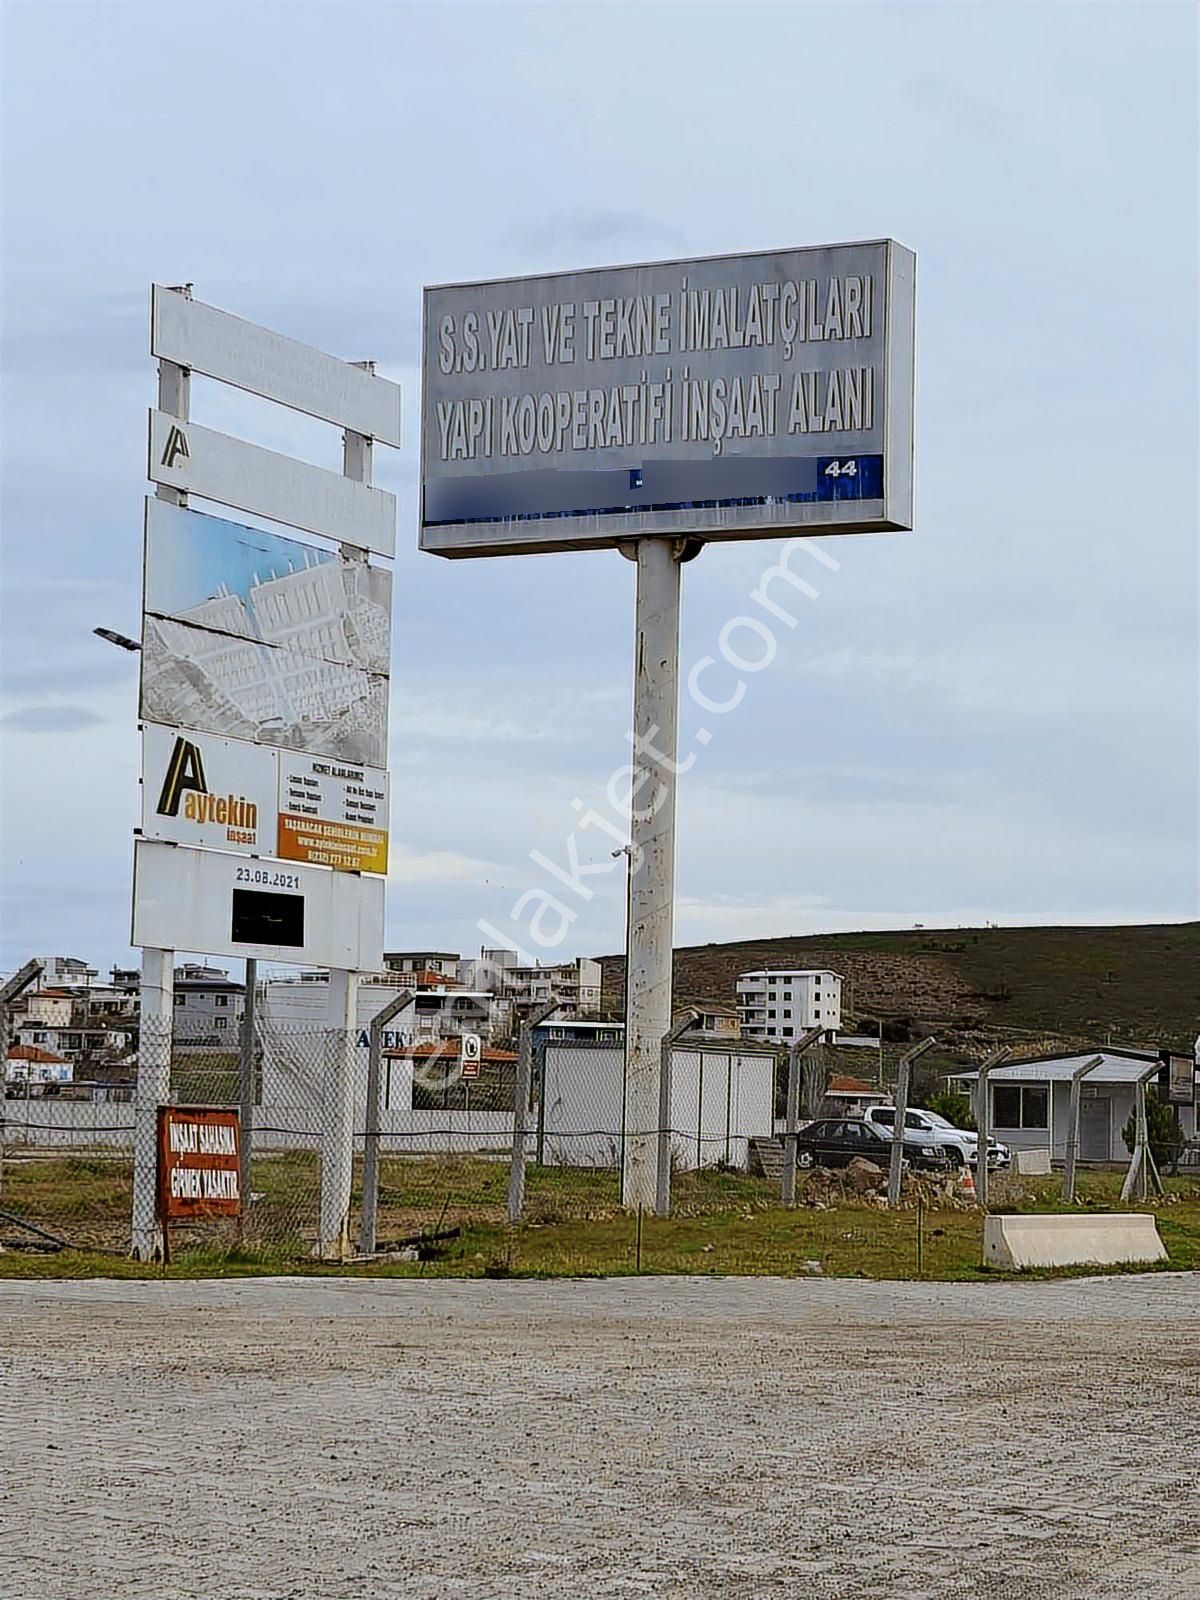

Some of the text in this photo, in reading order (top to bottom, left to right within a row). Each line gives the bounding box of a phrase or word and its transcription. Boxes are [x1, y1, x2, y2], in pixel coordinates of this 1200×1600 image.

[542, 303, 576, 364] VE
[583, 292, 672, 361] TEKNE
[679, 275, 873, 361] İMALATÇILARI
[437, 366, 874, 460] YAPI KOOPERATİFİ İNŞAAT ALANI
[825, 460, 857, 476] 44
[185, 793, 257, 829] aytekin
[237, 868, 299, 889] 23.08.2021
[169, 1115, 198, 1160] İNŞAAT
[171, 1161, 202, 1199] GİRMEK
